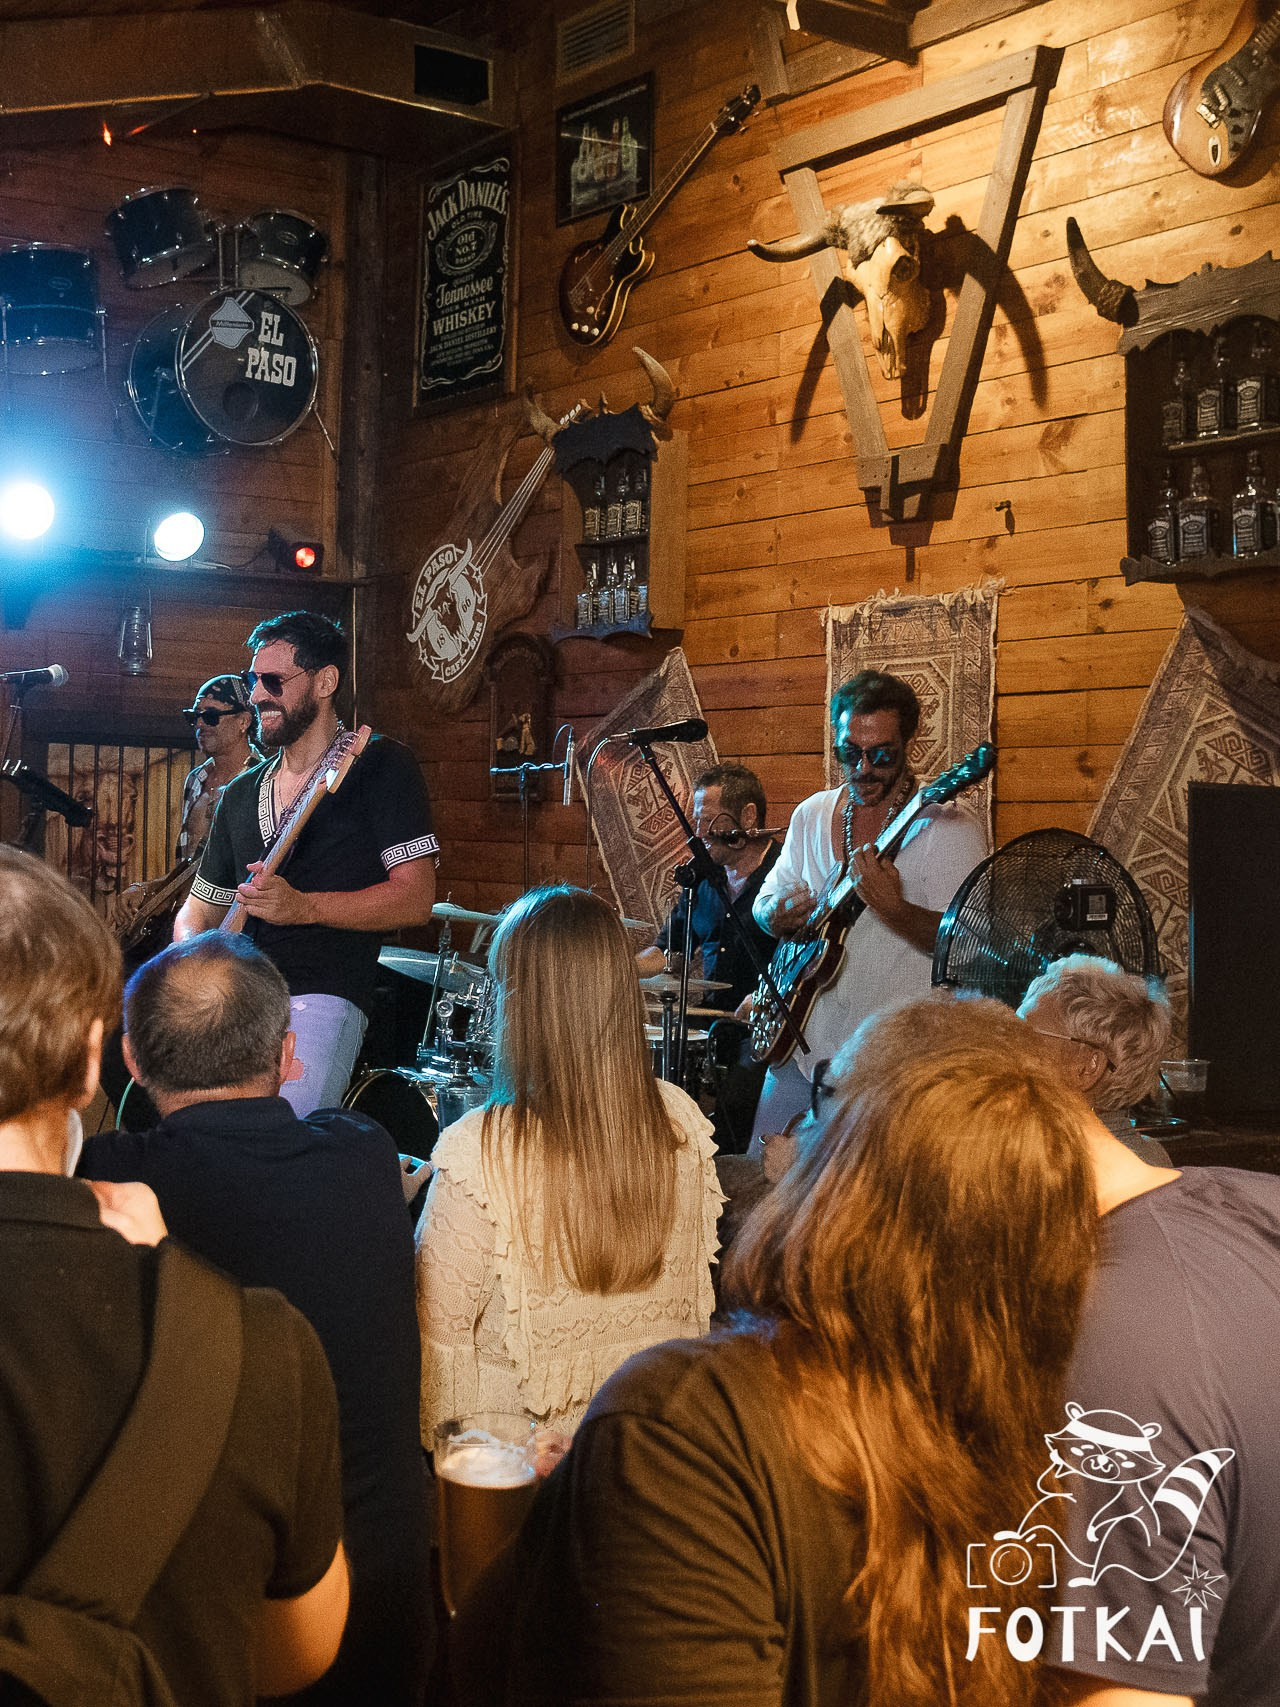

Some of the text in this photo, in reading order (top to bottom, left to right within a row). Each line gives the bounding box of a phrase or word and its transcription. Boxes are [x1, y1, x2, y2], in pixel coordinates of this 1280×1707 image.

[427, 192, 458, 240] JACK
[435, 276, 493, 308] Tennessee
[258, 311, 284, 346] EL
[433, 300, 496, 336] WHISKEY
[245, 347, 297, 387] PASO
[415, 550, 454, 610] EL PASO
